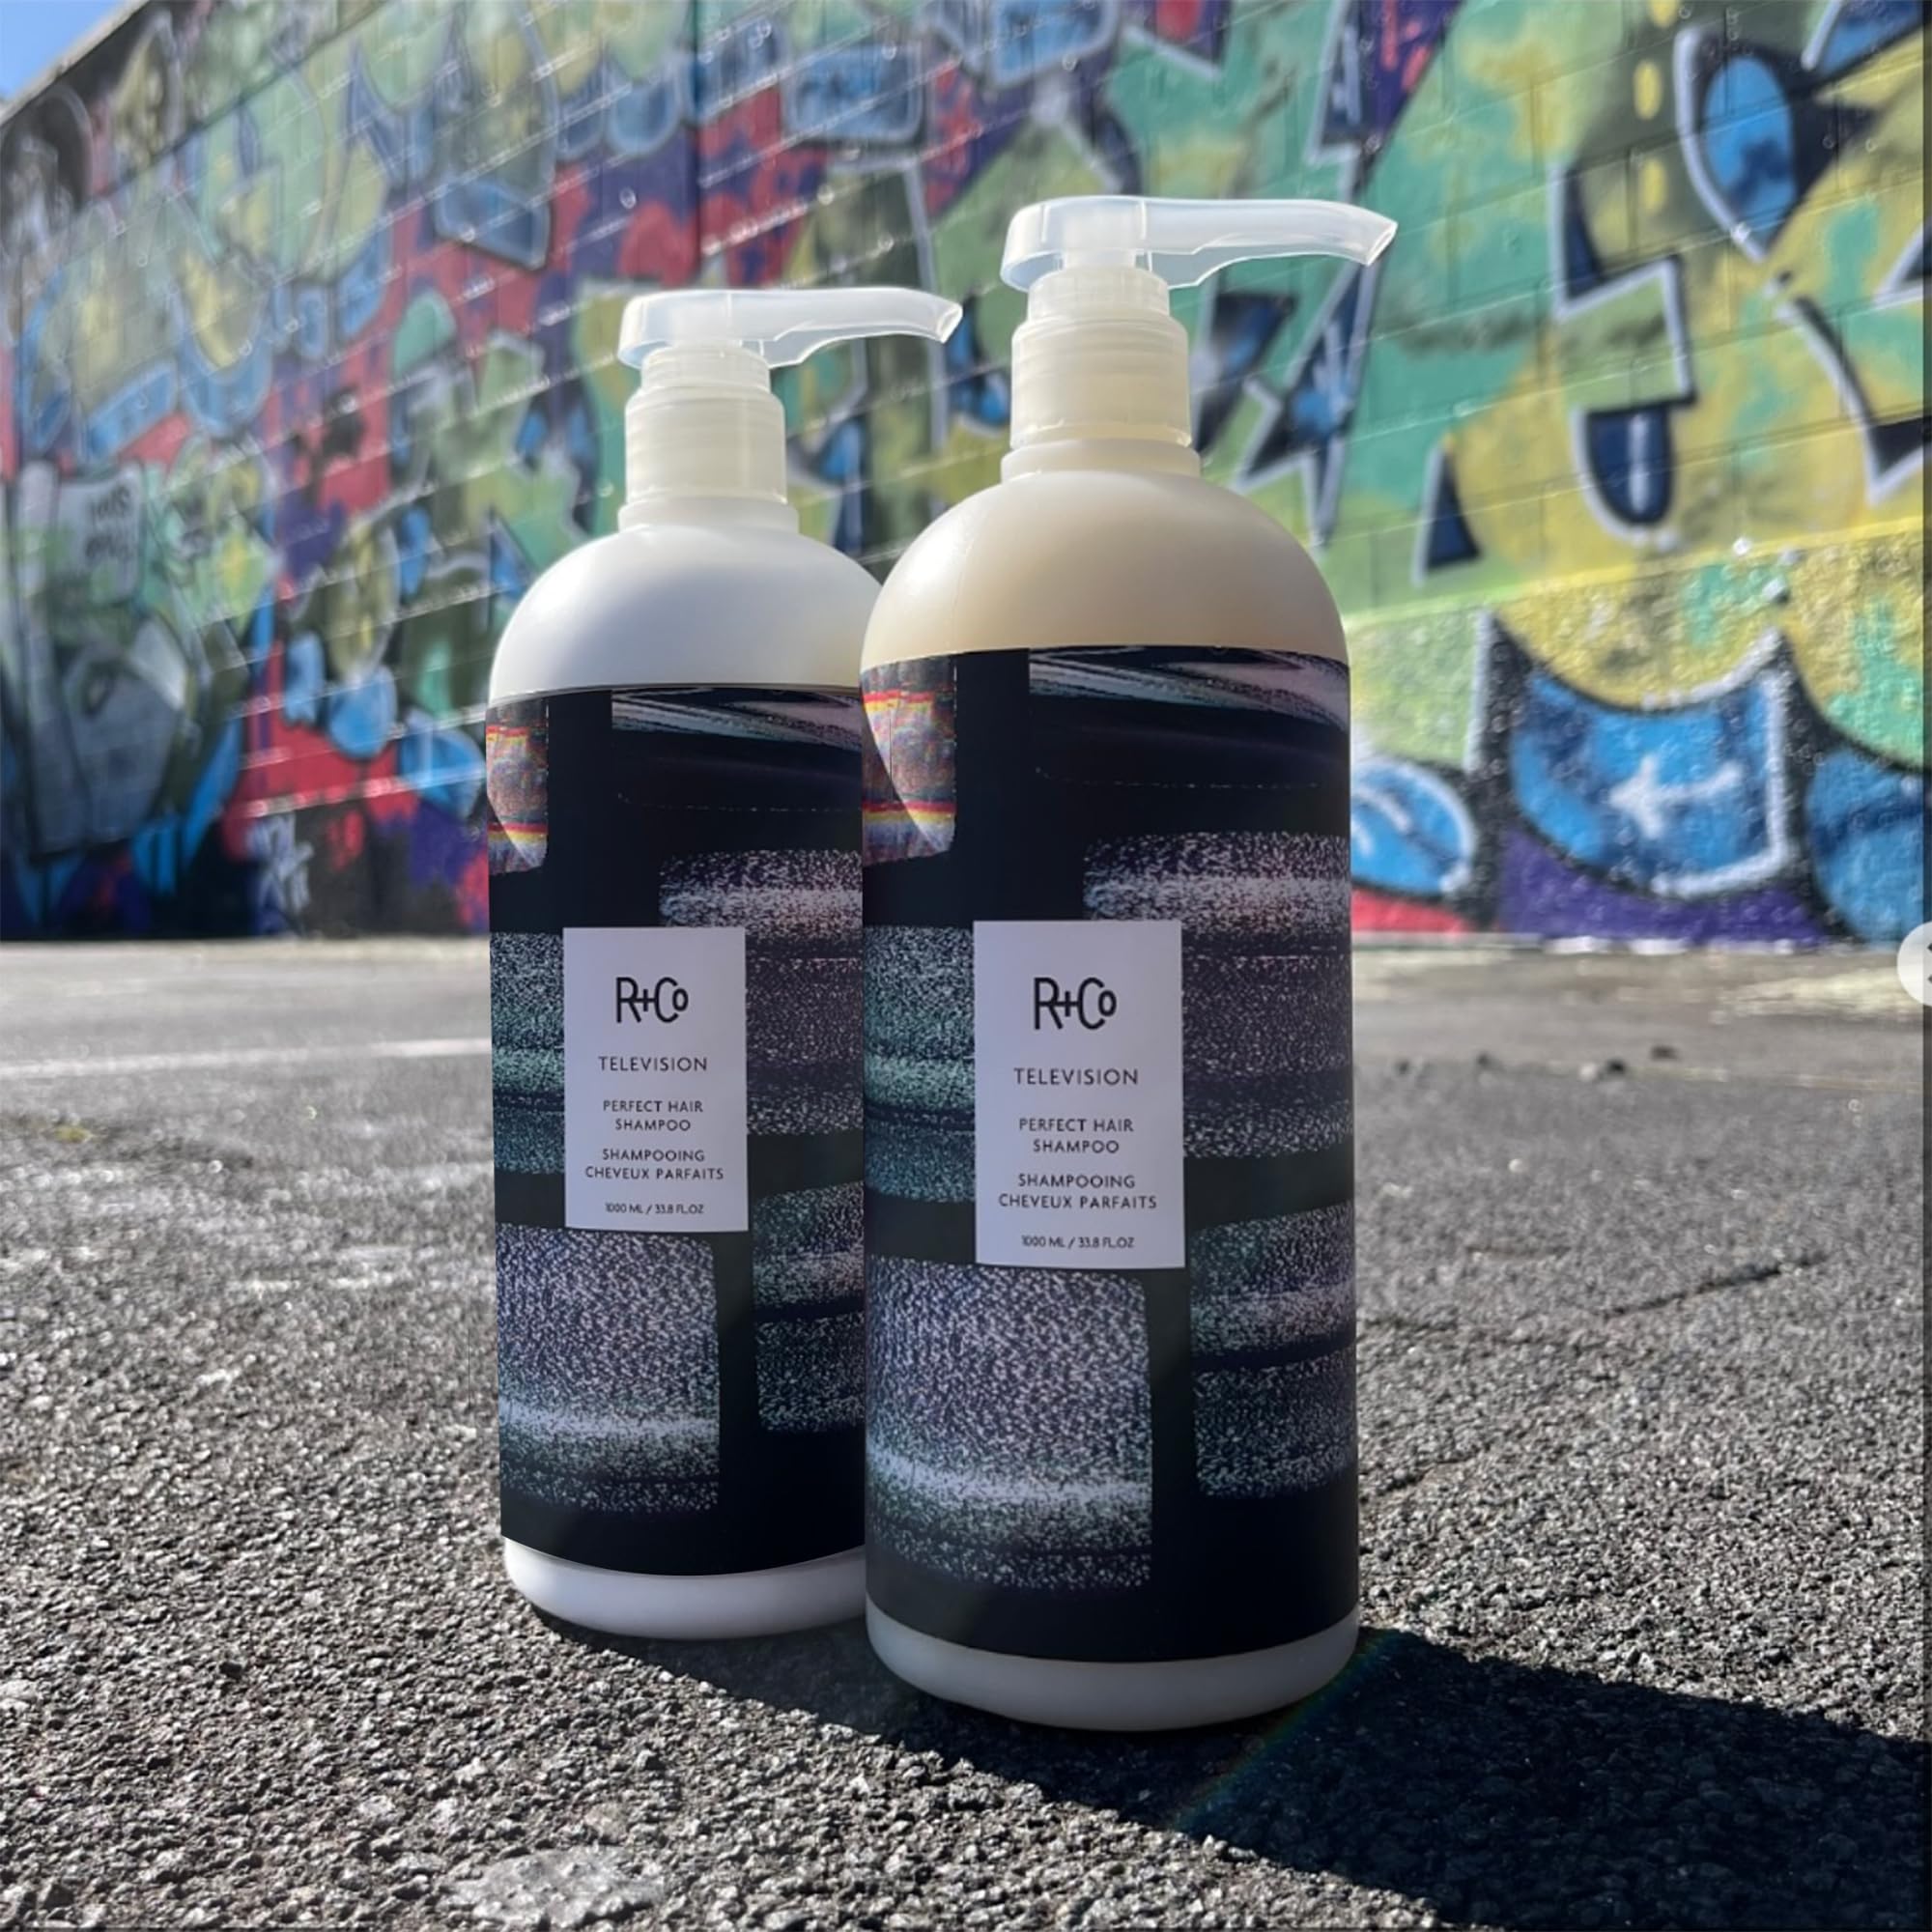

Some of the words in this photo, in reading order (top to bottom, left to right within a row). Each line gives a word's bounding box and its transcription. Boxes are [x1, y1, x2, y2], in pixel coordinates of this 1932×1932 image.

[615, 977, 690, 1024] R+Co
[1033, 977, 1118, 1031] R+Co
[598, 1056, 708, 1072] TELEVISION
[1013, 1067, 1138, 1086] TELEVISION
[603, 1099, 663, 1113] PERFECT
[668, 1099, 703, 1113] HAIR
[614, 1118, 692, 1132] SHAMPOO
[1019, 1118, 1087, 1132] PERFECT
[1093, 1118, 1134, 1132] HAIR
[1033, 1138, 1120, 1154] SHAMPOO
[602, 1148, 705, 1162] SHAMPOOING
[584, 1165, 650, 1179] CHEVEUX
[656, 1166, 724, 1180] PARFAITS
[1018, 1173, 1136, 1189] SHAMPOOING
[998, 1192, 1072, 1208] CHEVEUX
[1079, 1194, 1157, 1209] PARFAITS
[605, 1203, 627, 1214] 1000
[629, 1204, 643, 1214] ML
[1021, 1235, 1046, 1247] 1000
[1049, 1236, 1065, 1248] ML
